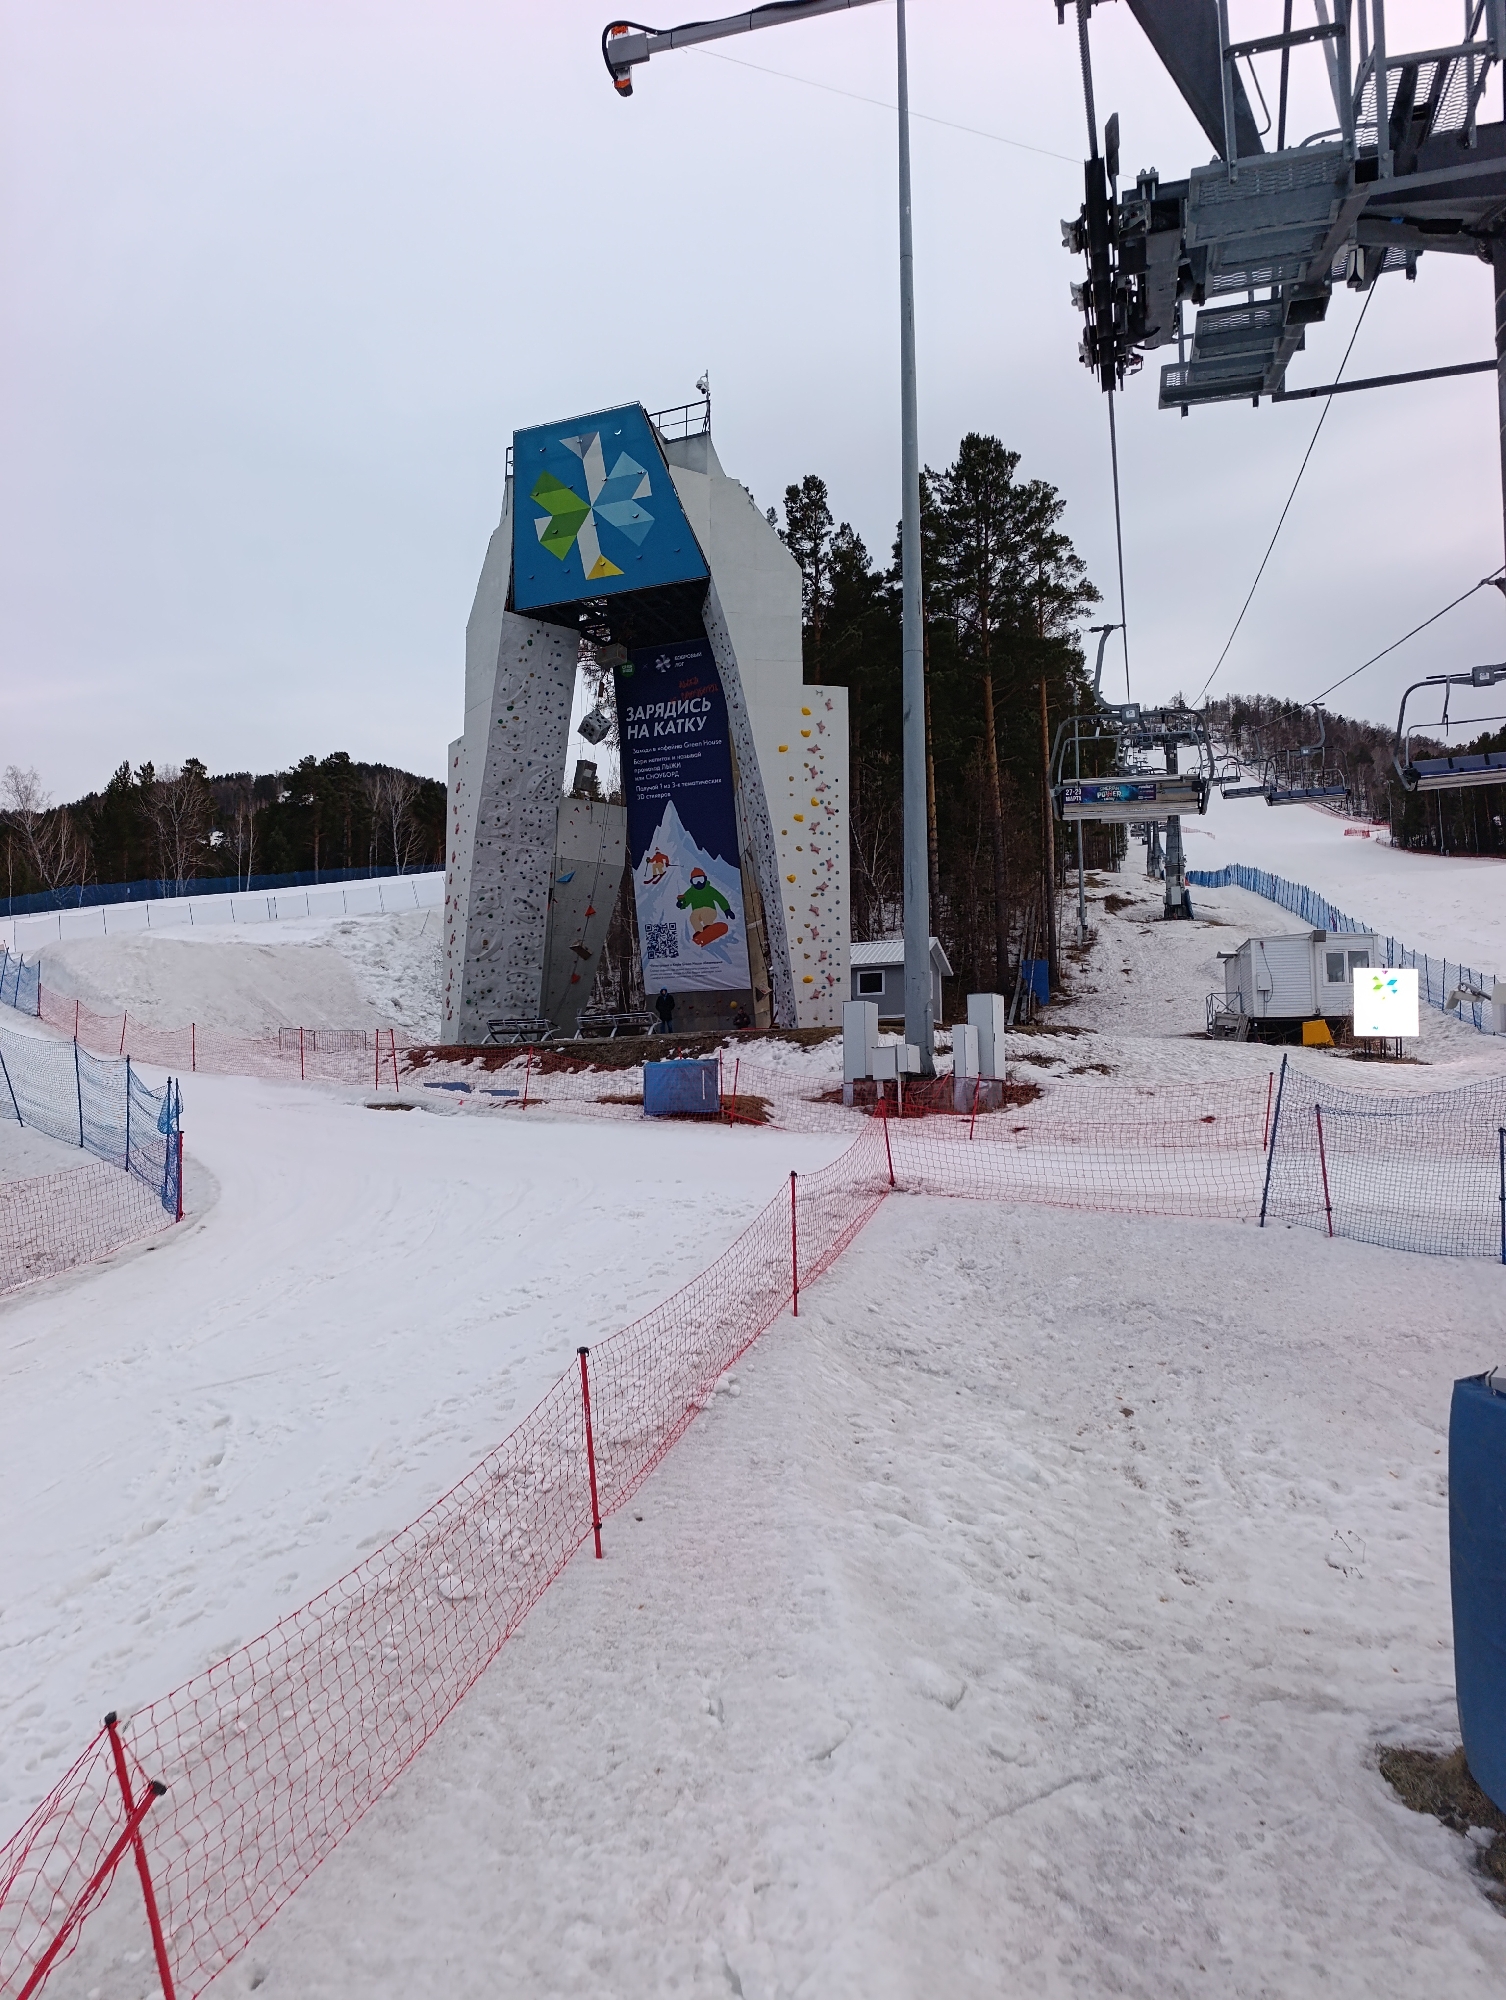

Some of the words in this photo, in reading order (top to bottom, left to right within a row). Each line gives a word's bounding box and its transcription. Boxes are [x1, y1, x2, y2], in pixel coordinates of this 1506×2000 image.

[626, 697, 712, 722] ЗАРЯДИСЬ
[627, 723, 650, 740] НА
[653, 715, 707, 737] КАТКУ
[683, 741, 702, 749] Green
[702, 738, 722, 747] House
[633, 758, 647, 766] Бери
[661, 762, 682, 770] ЛЫЖИ
[645, 770, 680, 780] СНОУБОРД
[636, 793, 645, 801] 3D
